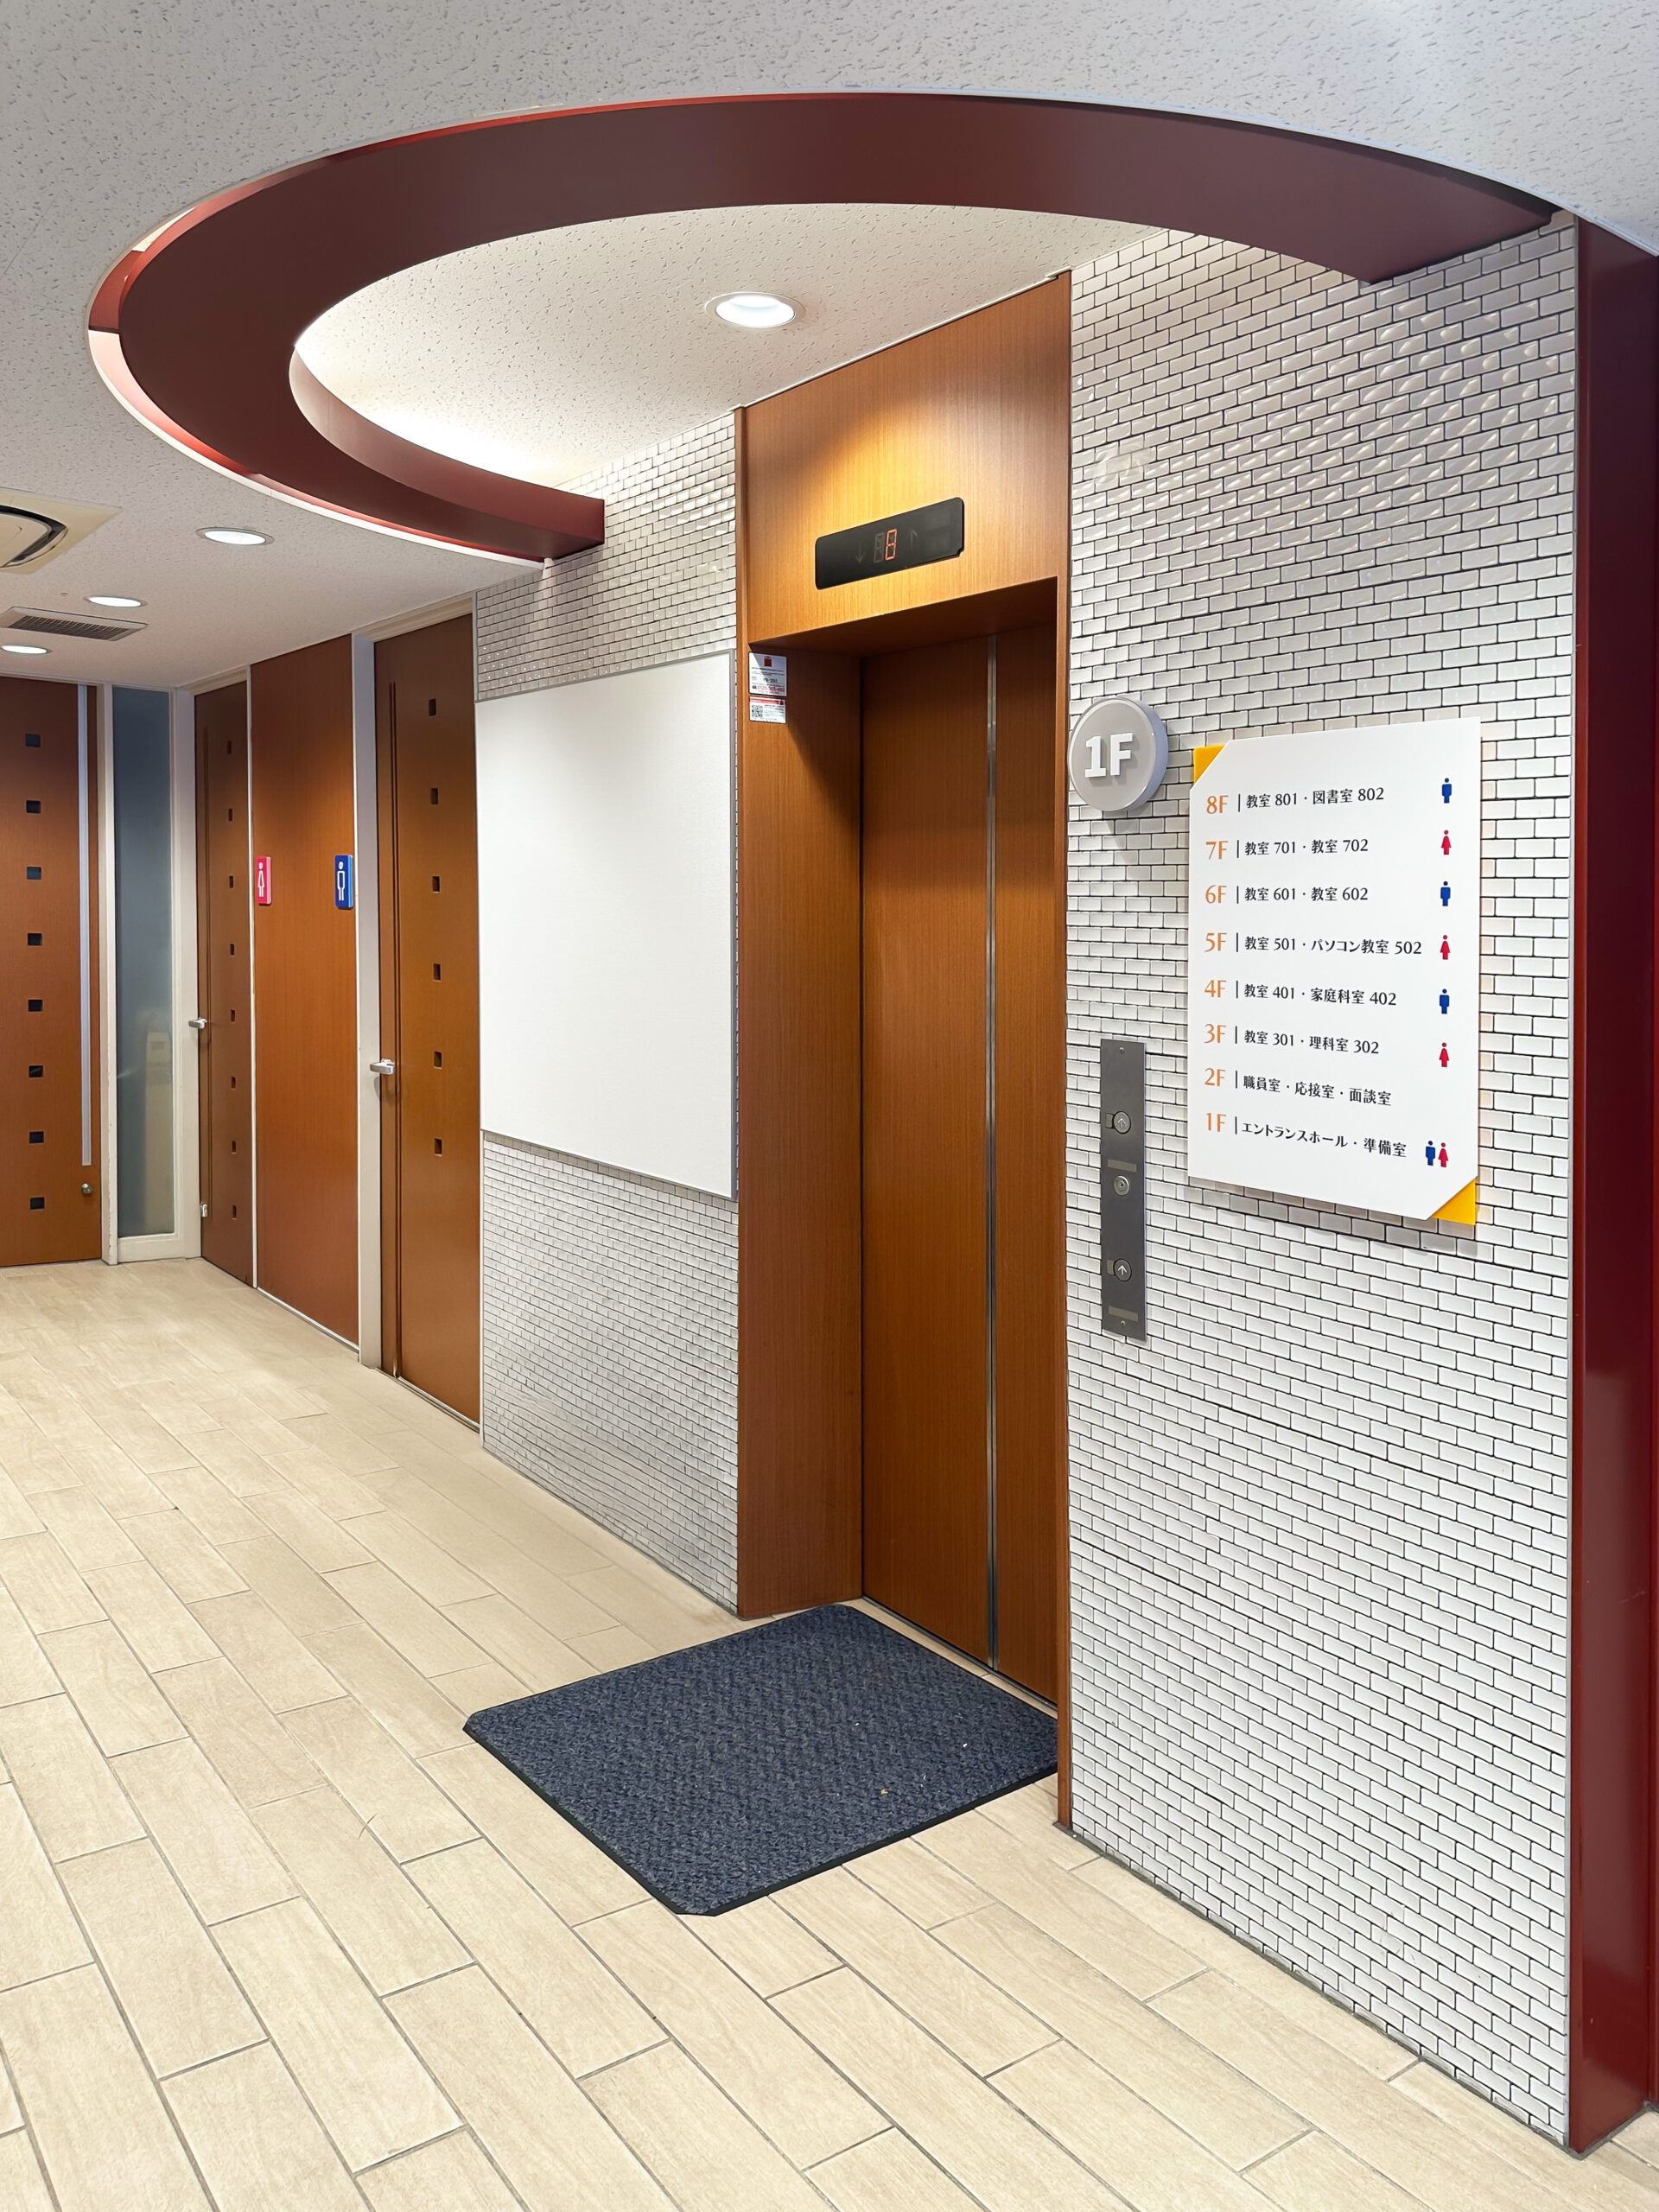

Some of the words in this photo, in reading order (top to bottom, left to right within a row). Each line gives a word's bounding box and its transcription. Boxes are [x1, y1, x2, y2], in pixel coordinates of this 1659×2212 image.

[1084, 732, 1134, 779] 1F
[1206, 794, 1229, 815] 8F
[1246, 793, 1271, 809] 教室
[1357, 786, 1384, 802] 802
[1205, 840, 1229, 860] 7F
[1244, 841, 1269, 856] 教室
[1342, 838, 1369, 852] 702
[1205, 884, 1227, 904] 6F
[1244, 887, 1269, 901] 教室
[1342, 887, 1369, 901] 602
[1205, 932, 1227, 952] 5F
[1244, 936, 1269, 950] 教室
[1395, 941, 1422, 955] 502
[1204, 979, 1227, 998] 4F
[1243, 983, 1268, 999] 教室
[1369, 991, 1397, 1006] 402
[1204, 1023, 1226, 1044] 3F
[1243, 1029, 1268, 1045] 教室
[1353, 1039, 1379, 1054] 302
[1205, 1067, 1225, 1087] 2F
[1206, 1112, 1226, 1133] 1F
